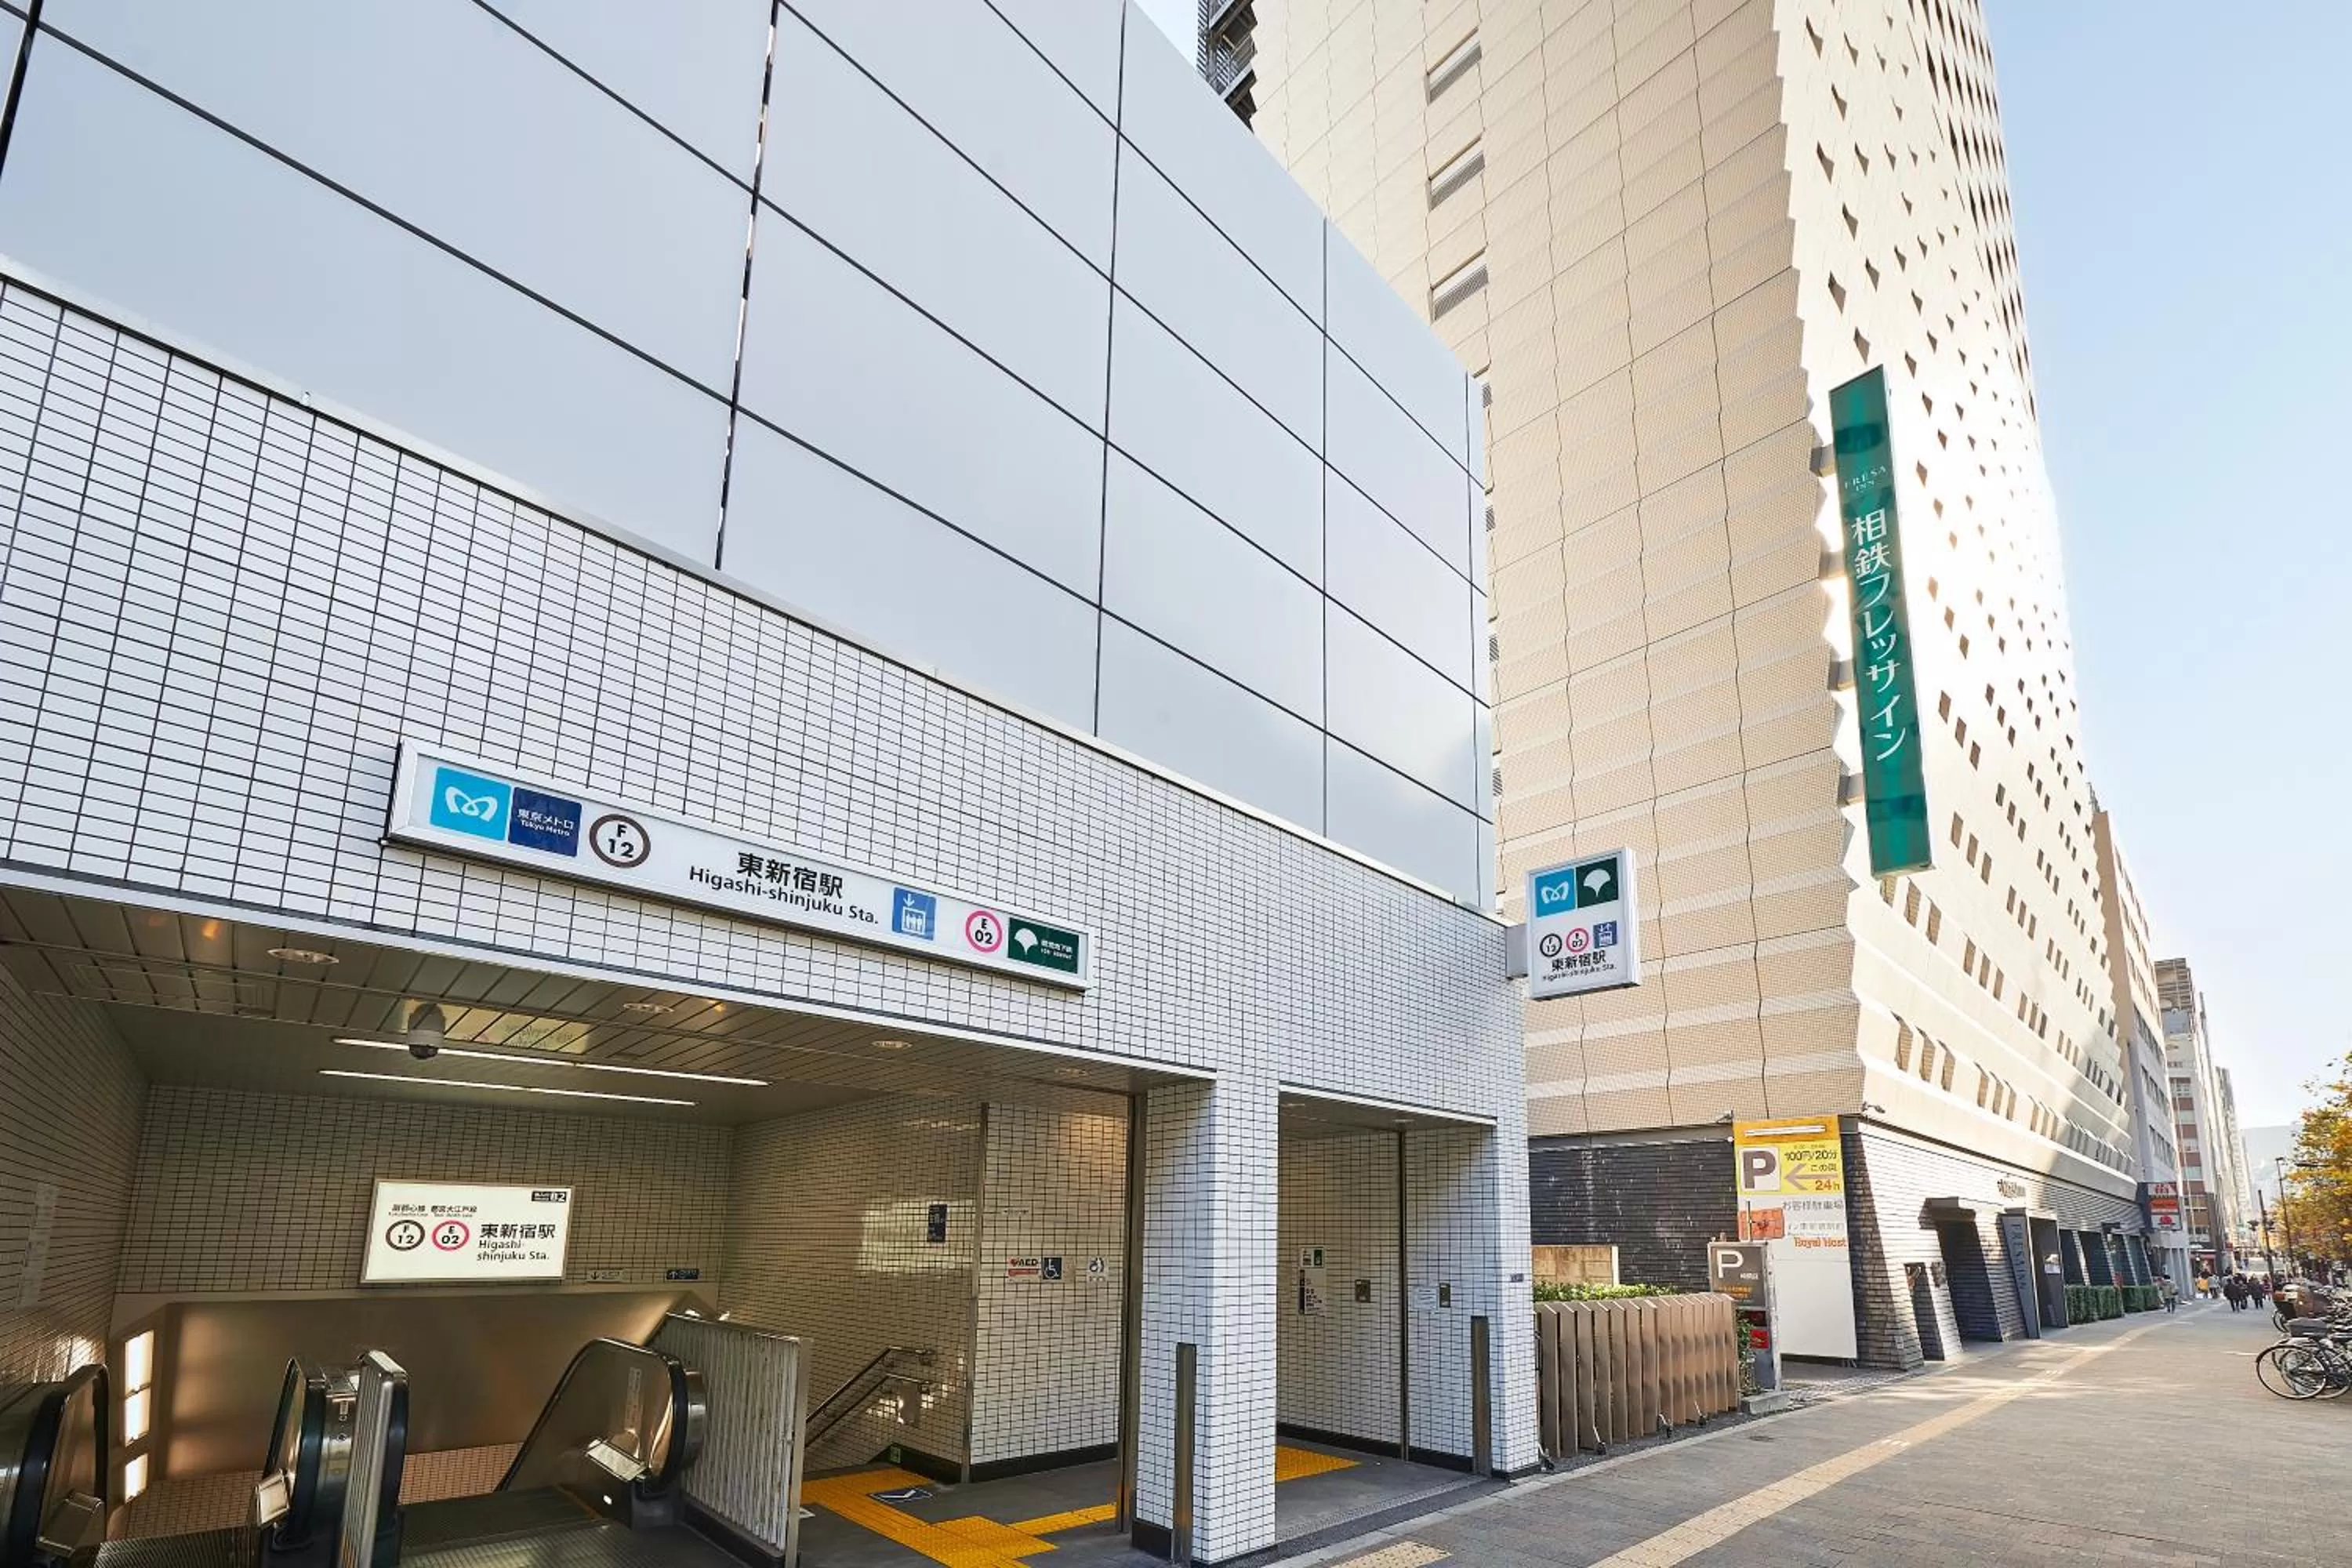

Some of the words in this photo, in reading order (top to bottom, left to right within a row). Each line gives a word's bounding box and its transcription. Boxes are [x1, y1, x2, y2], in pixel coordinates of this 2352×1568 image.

[1851, 508, 1906, 761] 相鉄フレッサイン
[517, 808, 574, 829] 東京メトロ
[521, 819, 544, 831] Tokyo
[546, 826, 570, 837] Metro
[617, 824, 627, 837] F
[608, 838, 634, 858] 12
[736, 851, 844, 899] 東新宿駅
[689, 865, 843, 916] Higashi-shinjuku
[848, 905, 879, 924] Sta.
[981, 918, 987, 930] E
[975, 930, 993, 945] 02
[1552, 949, 1606, 971] 東新宿駅
[1743, 1151, 1777, 1189] P
[403, 1225, 409, 1234] F
[448, 1225, 456, 1234] E
[480, 1223, 556, 1240] 東新宿駅
[397, 1235, 415, 1244] 12
[441, 1235, 459, 1244] 02
[477, 1250, 525, 1263] shinjuku
[529, 1251, 550, 1261] Sta.
[1716, 1250, 1744, 1279] P
